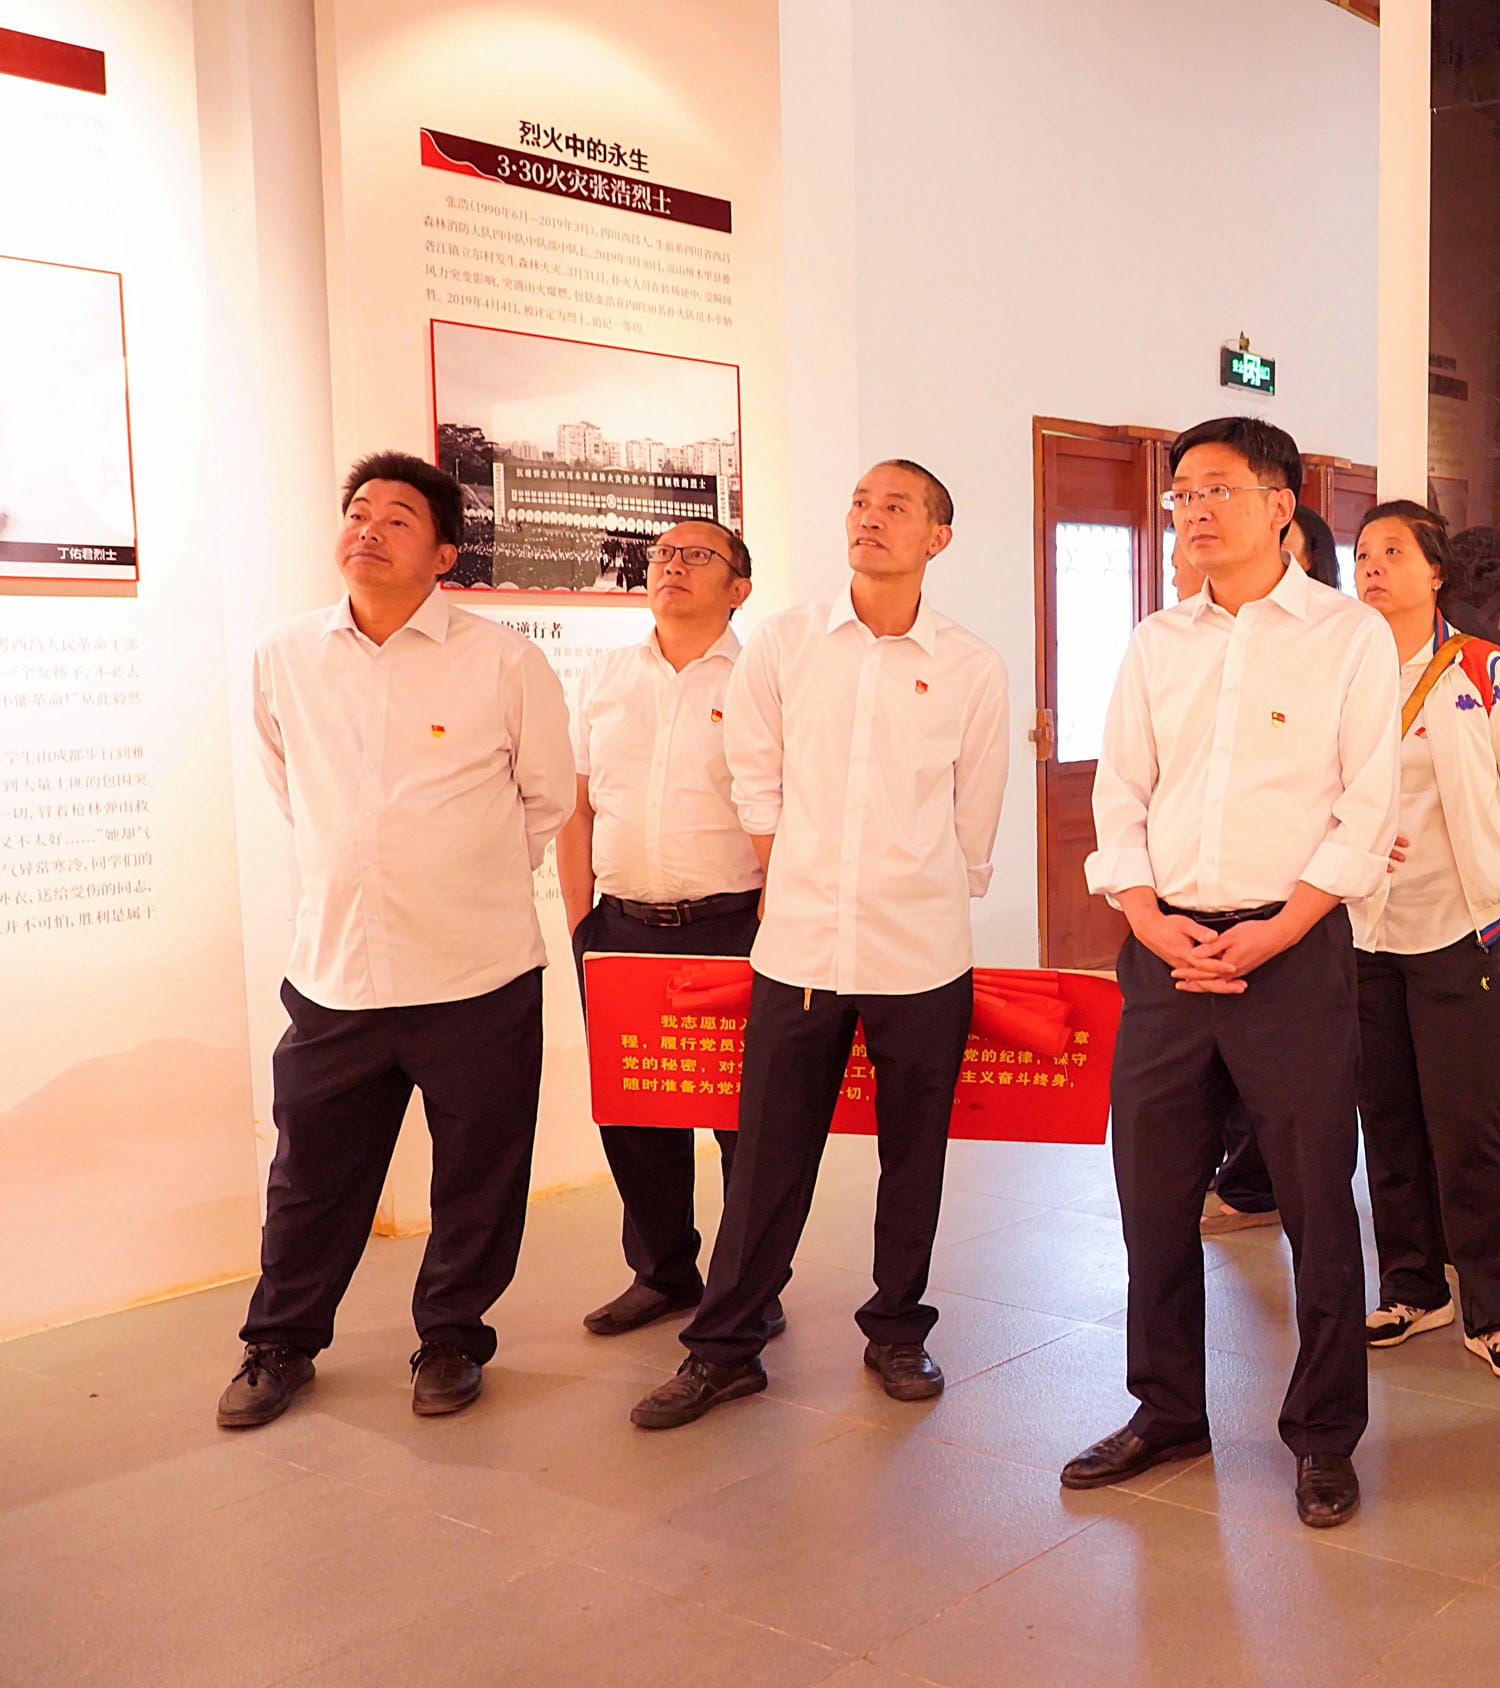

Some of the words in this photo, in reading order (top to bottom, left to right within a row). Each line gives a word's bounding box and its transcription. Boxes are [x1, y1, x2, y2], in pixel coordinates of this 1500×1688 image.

[518, 120, 650, 173] 烈火中的永生
[496, 154, 672, 215] 3·30火灾张浩烈士
[57, 546, 118, 562] 丁佑君烈士
[1074, 1031, 1090, 1044] 章
[622, 1056, 742, 1074] 党的秘密，对
[623, 1077, 741, 1095] 随时准备为党
